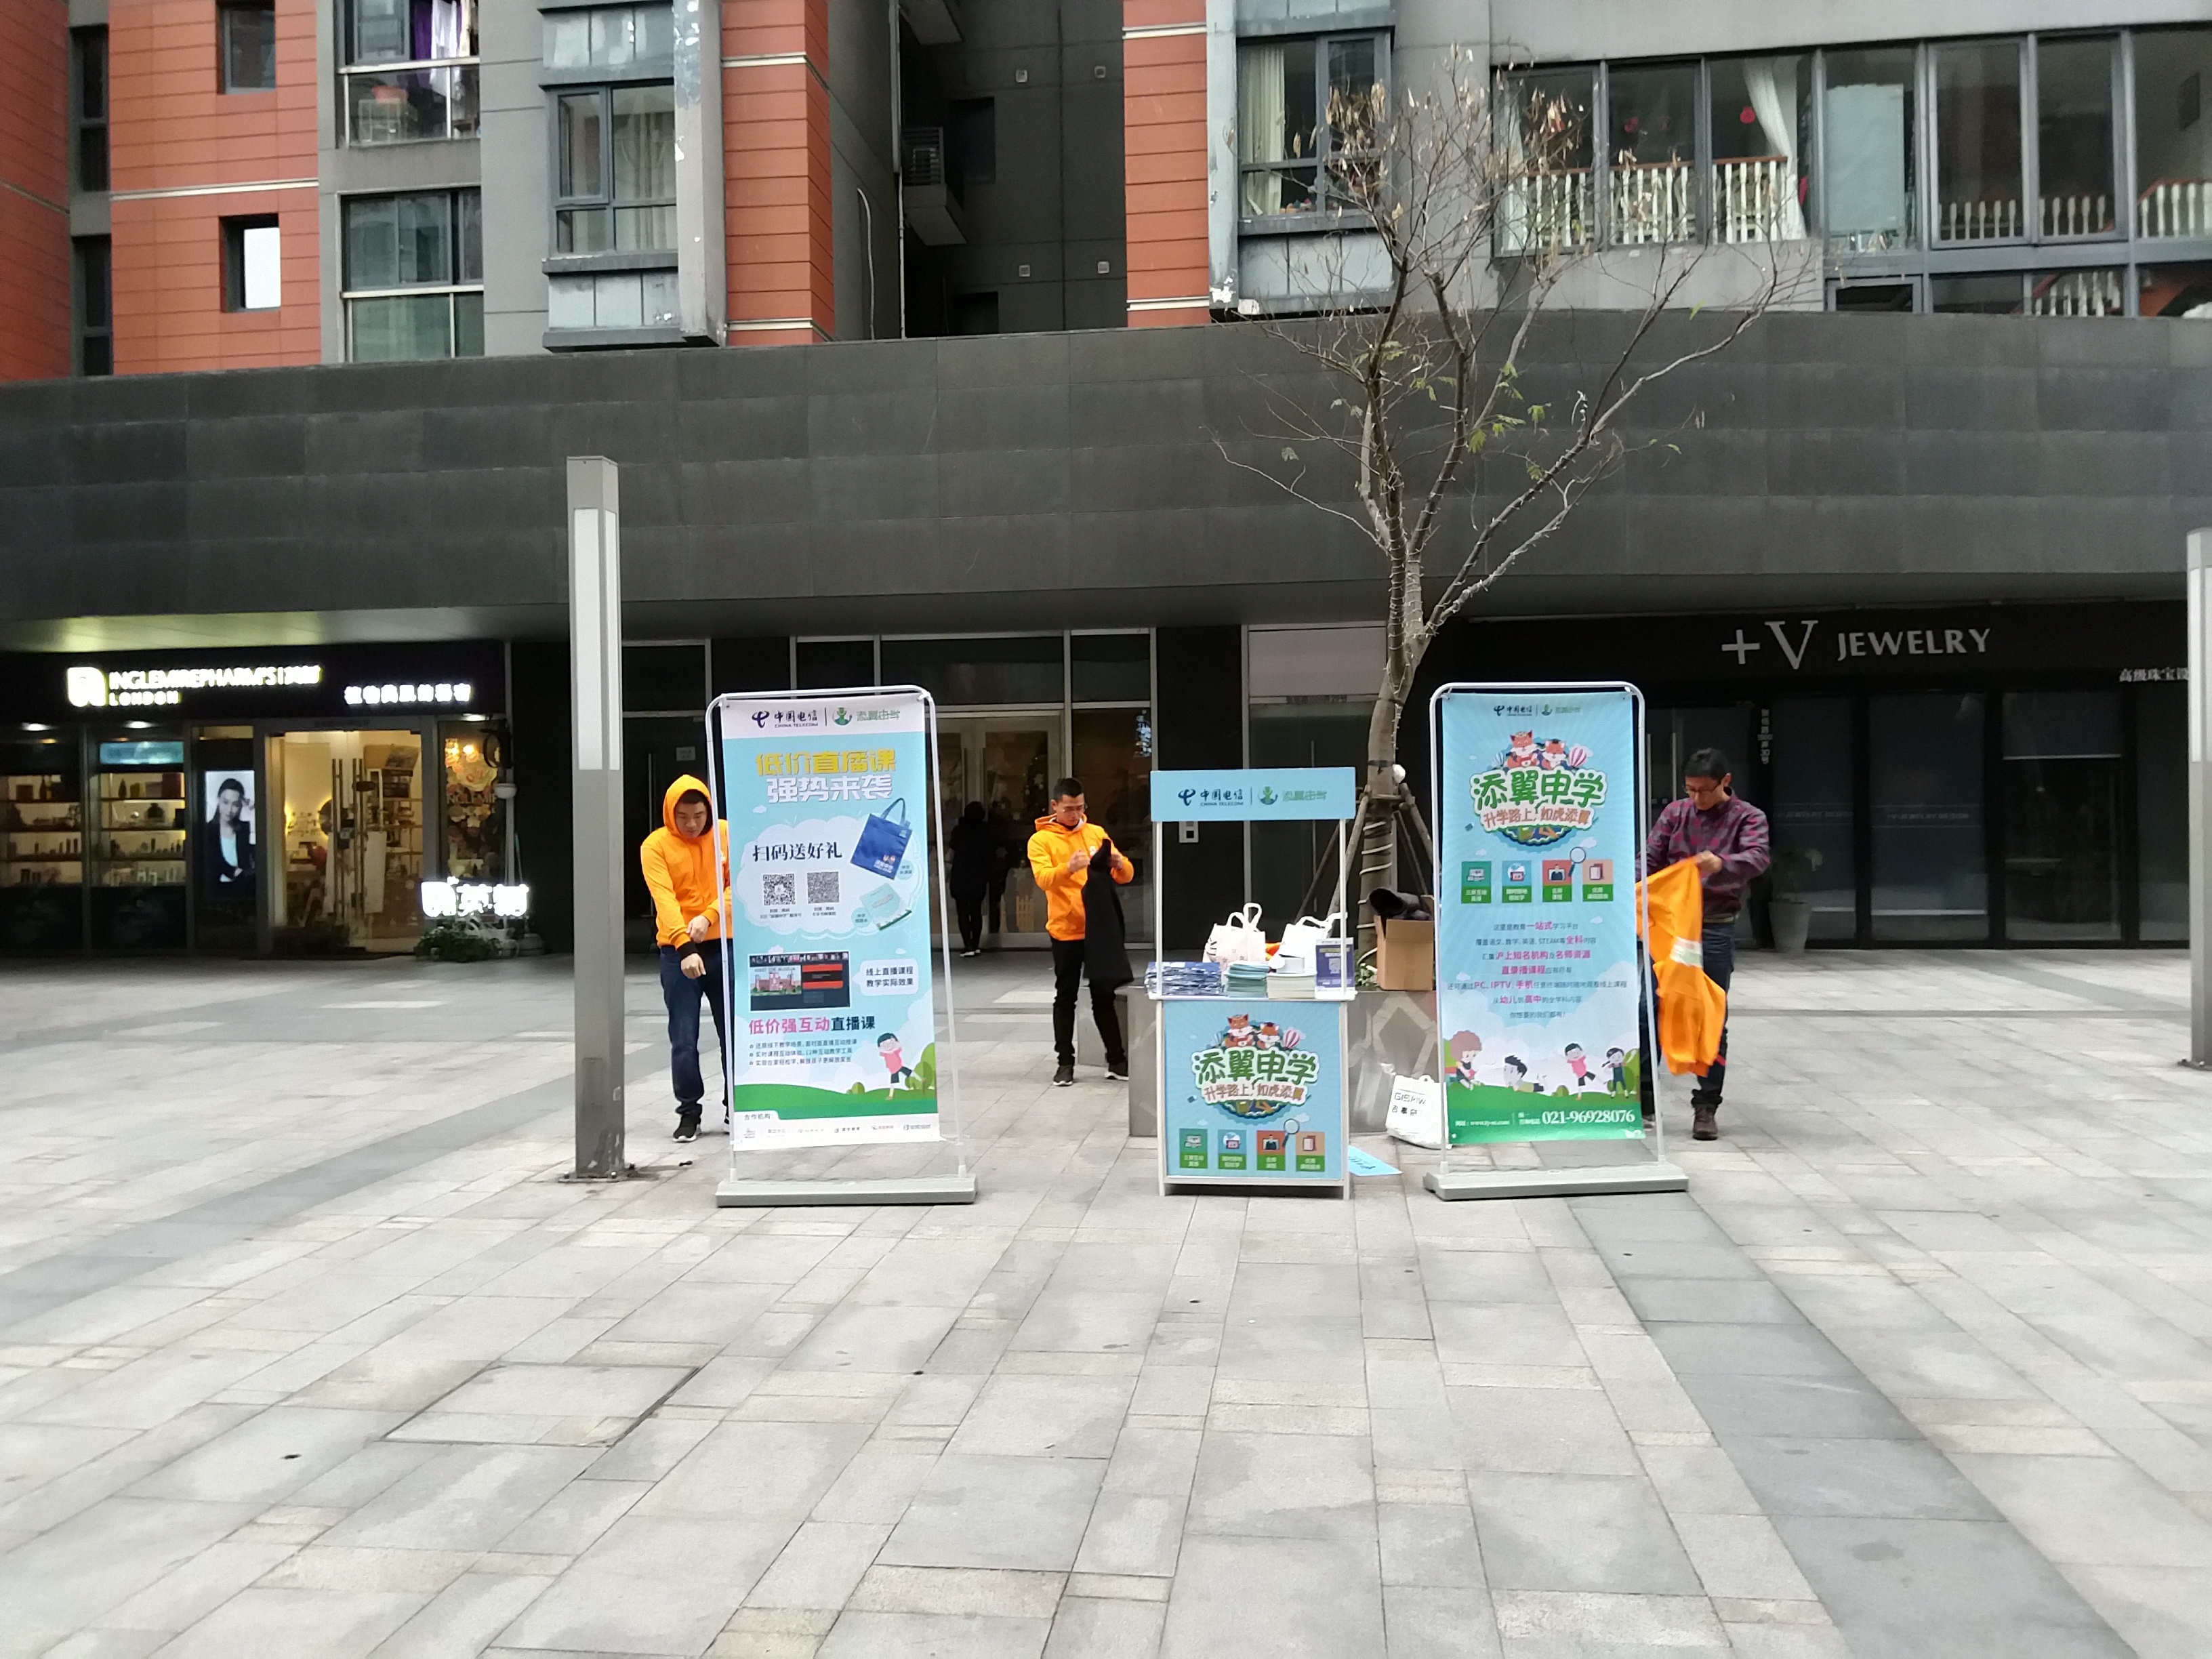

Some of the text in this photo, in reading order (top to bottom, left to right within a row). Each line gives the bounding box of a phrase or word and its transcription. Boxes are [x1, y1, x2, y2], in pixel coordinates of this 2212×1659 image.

[1837, 628, 1990, 661] JEWELRY
[109, 691, 181, 706] LONDON
[774, 710, 817, 722] 中国电信
[756, 748, 896, 776] 低价直播课
[766, 774, 892, 804] 强势来袭
[1200, 788, 1243, 801] 中国电信
[1473, 770, 1604, 810] 添翼申学
[752, 842, 842, 862] 扫码送好礼
[866, 966, 914, 976] 线上直播课程
[866, 978, 914, 987] 教学实际效果
[749, 1016, 876, 1034] 低价强互动直播课
[1194, 1050, 1317, 1085] 添翼申学
[1542, 1109, 1635, 1125] 021-96928076
